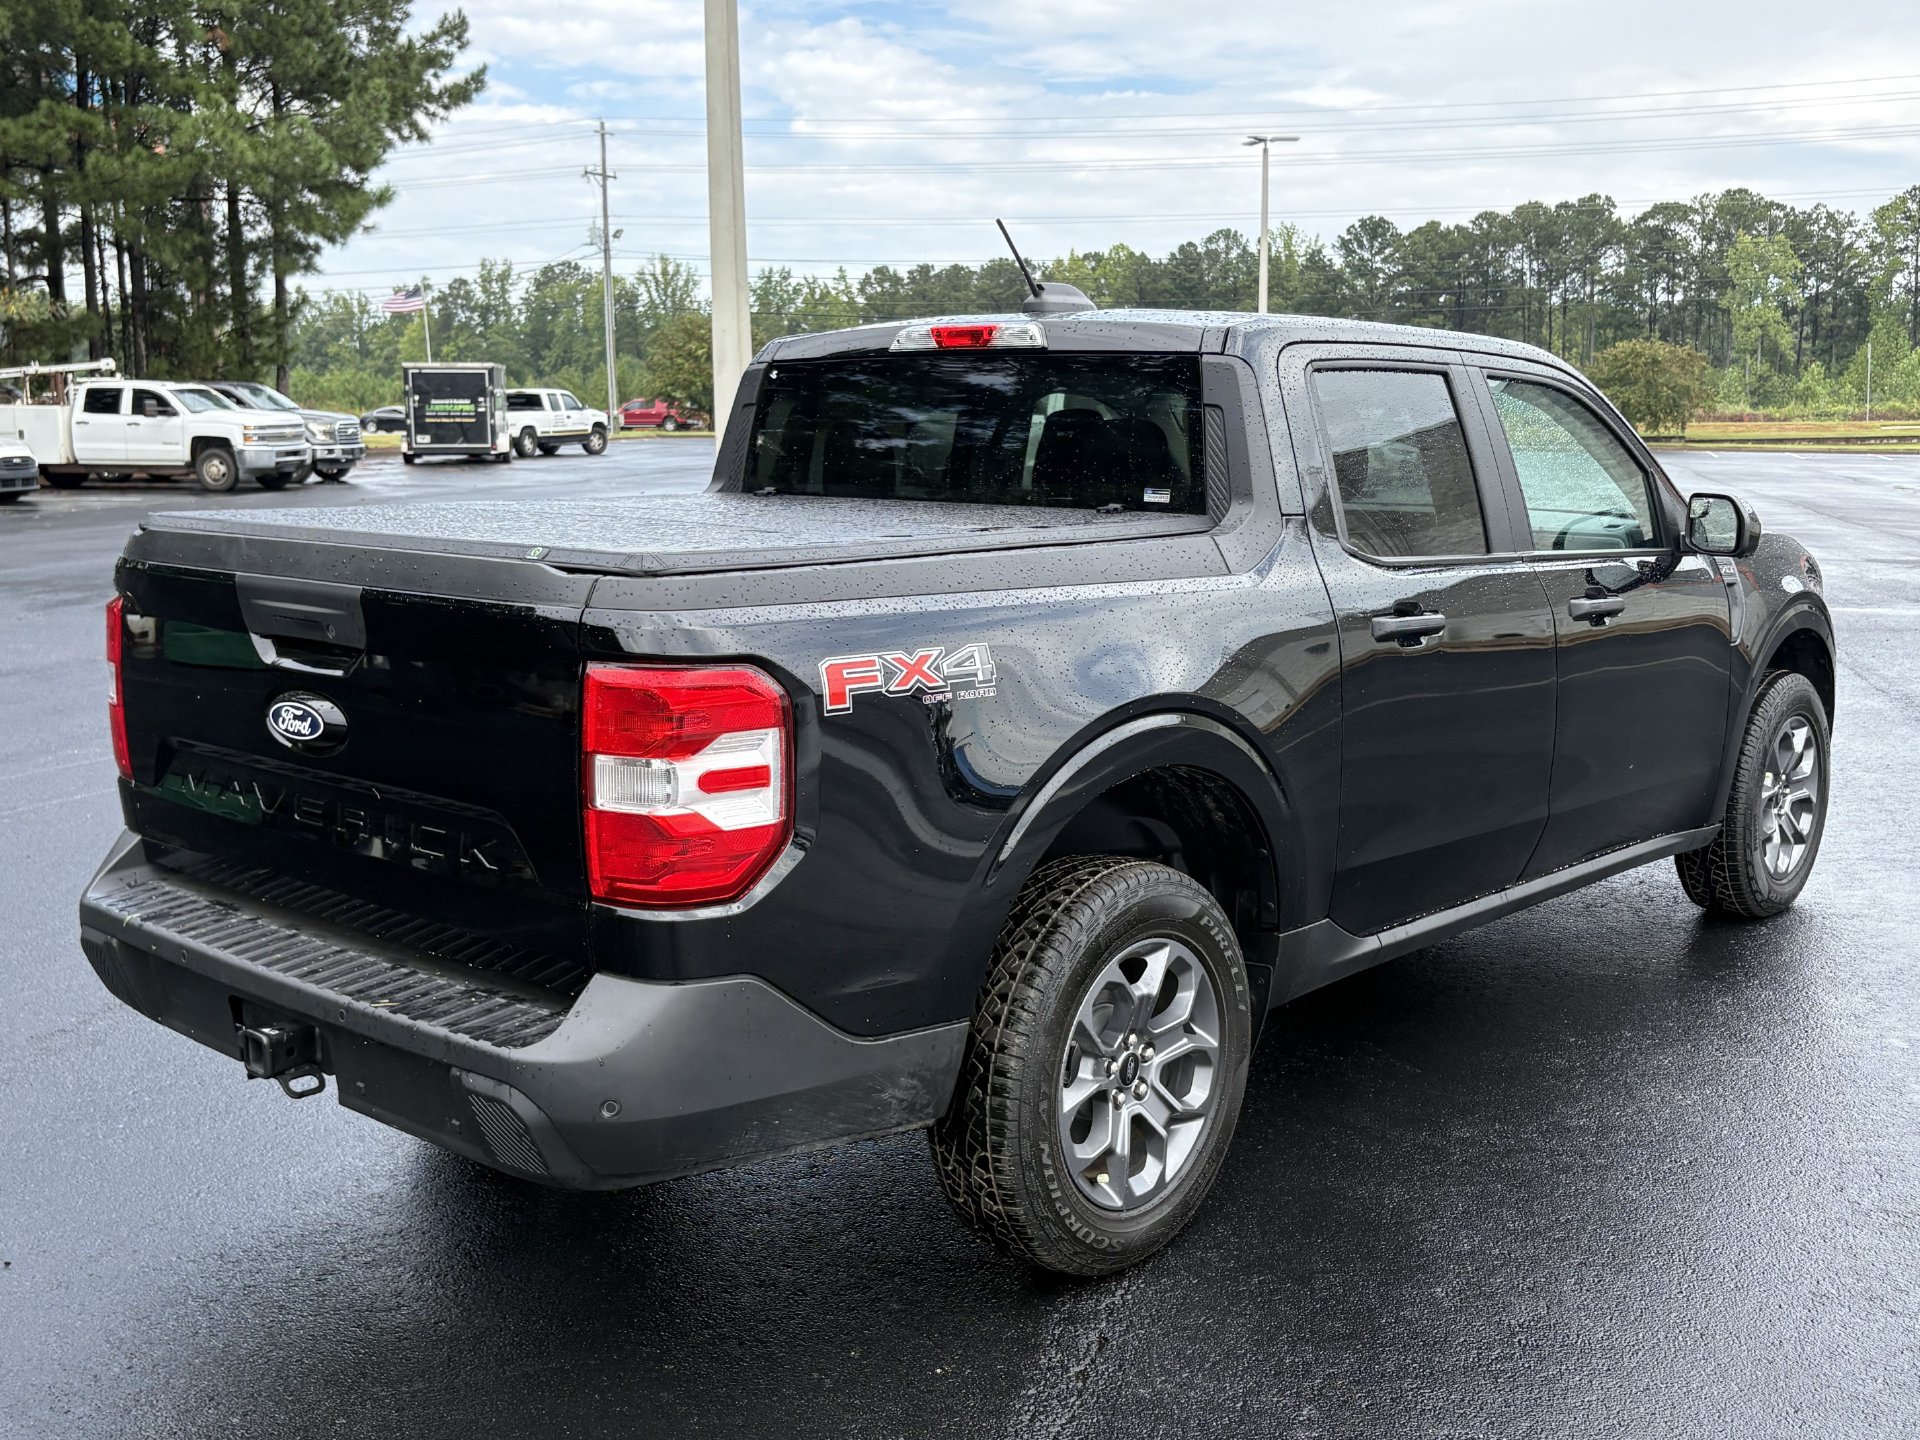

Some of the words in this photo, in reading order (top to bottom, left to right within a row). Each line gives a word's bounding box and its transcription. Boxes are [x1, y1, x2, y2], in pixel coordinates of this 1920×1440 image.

[277, 705, 312, 736] Ford
[818, 642, 997, 716] FX4
[922, 692, 953, 705] OFF
[957, 687, 997, 700] ROAD
[182, 771, 500, 871] MAVERICK
[1199, 915, 1247, 1011] PIRELLI
[1038, 1141, 1125, 1252] SCORPION
